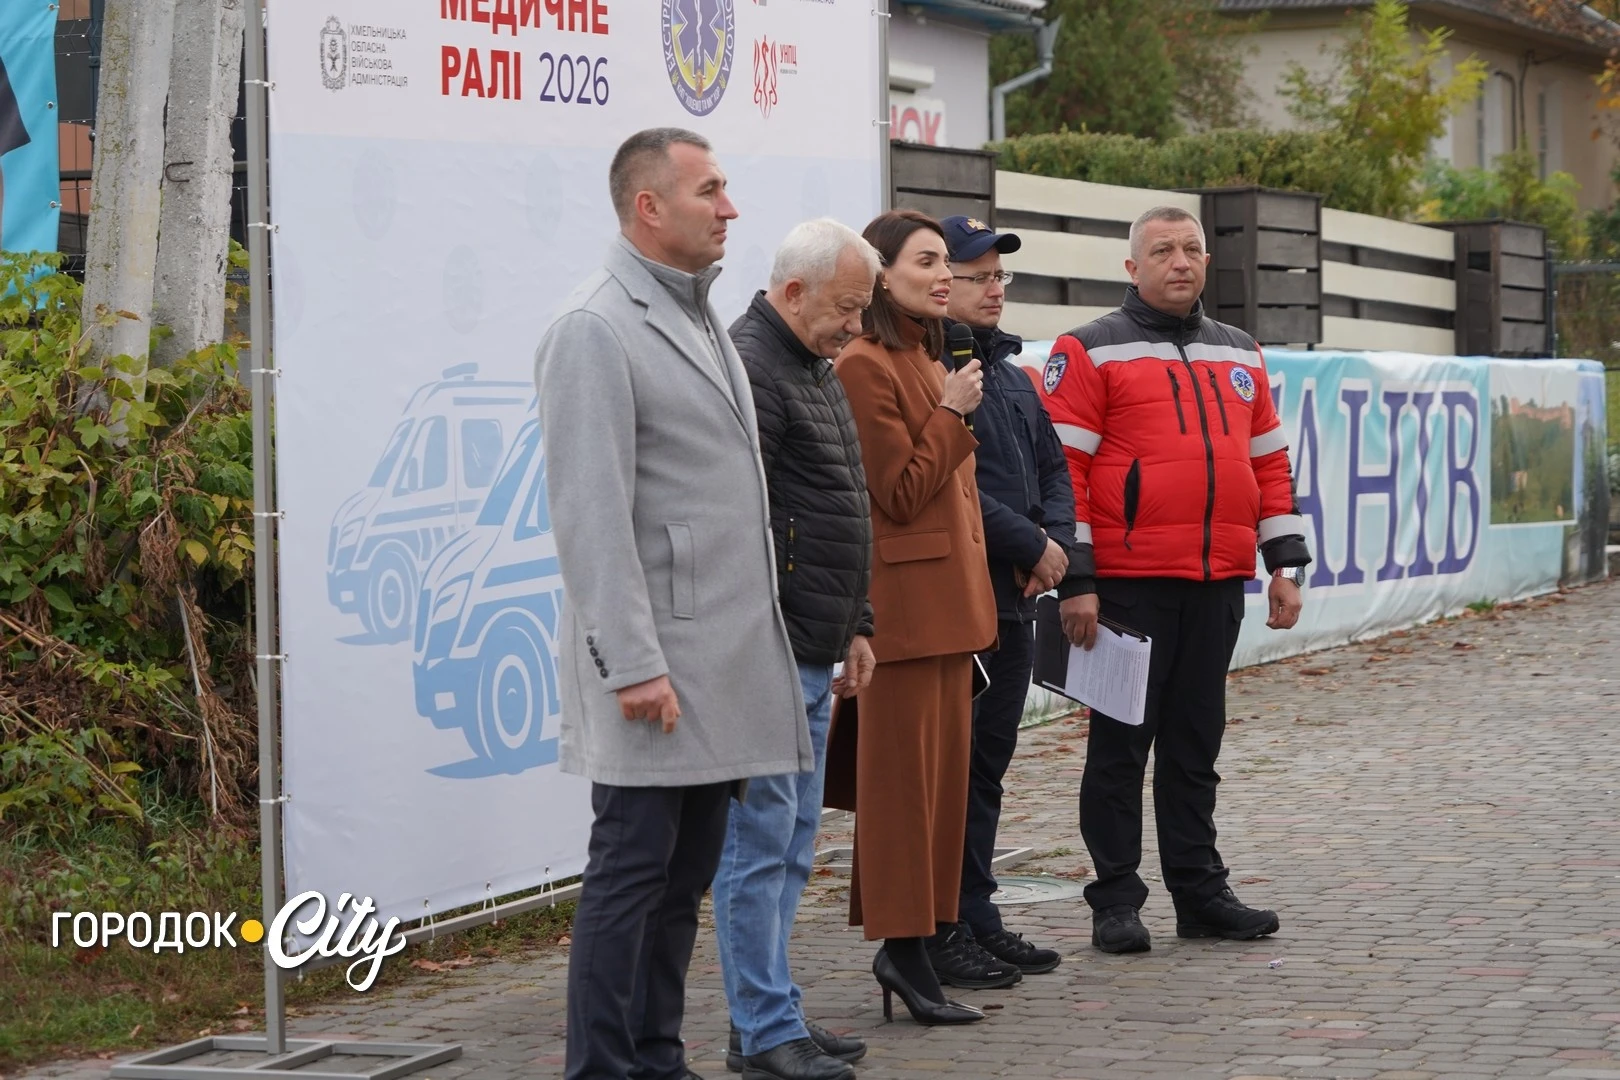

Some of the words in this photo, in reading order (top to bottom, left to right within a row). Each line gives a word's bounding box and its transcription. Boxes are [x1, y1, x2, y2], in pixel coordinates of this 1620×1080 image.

[350, 24, 407, 40] ХМЕЛЬНИЦЬКА
[351, 41, 387, 54] ОБЛАСНА
[351, 55, 393, 70] ВІЙСЬКОВА
[351, 73, 408, 88] АДМІНІСТРАЦІЯ
[441, 45, 522, 100] РАЛІ
[538, 51, 609, 106] 2026
[1244, 384, 1481, 594] АНІВ
